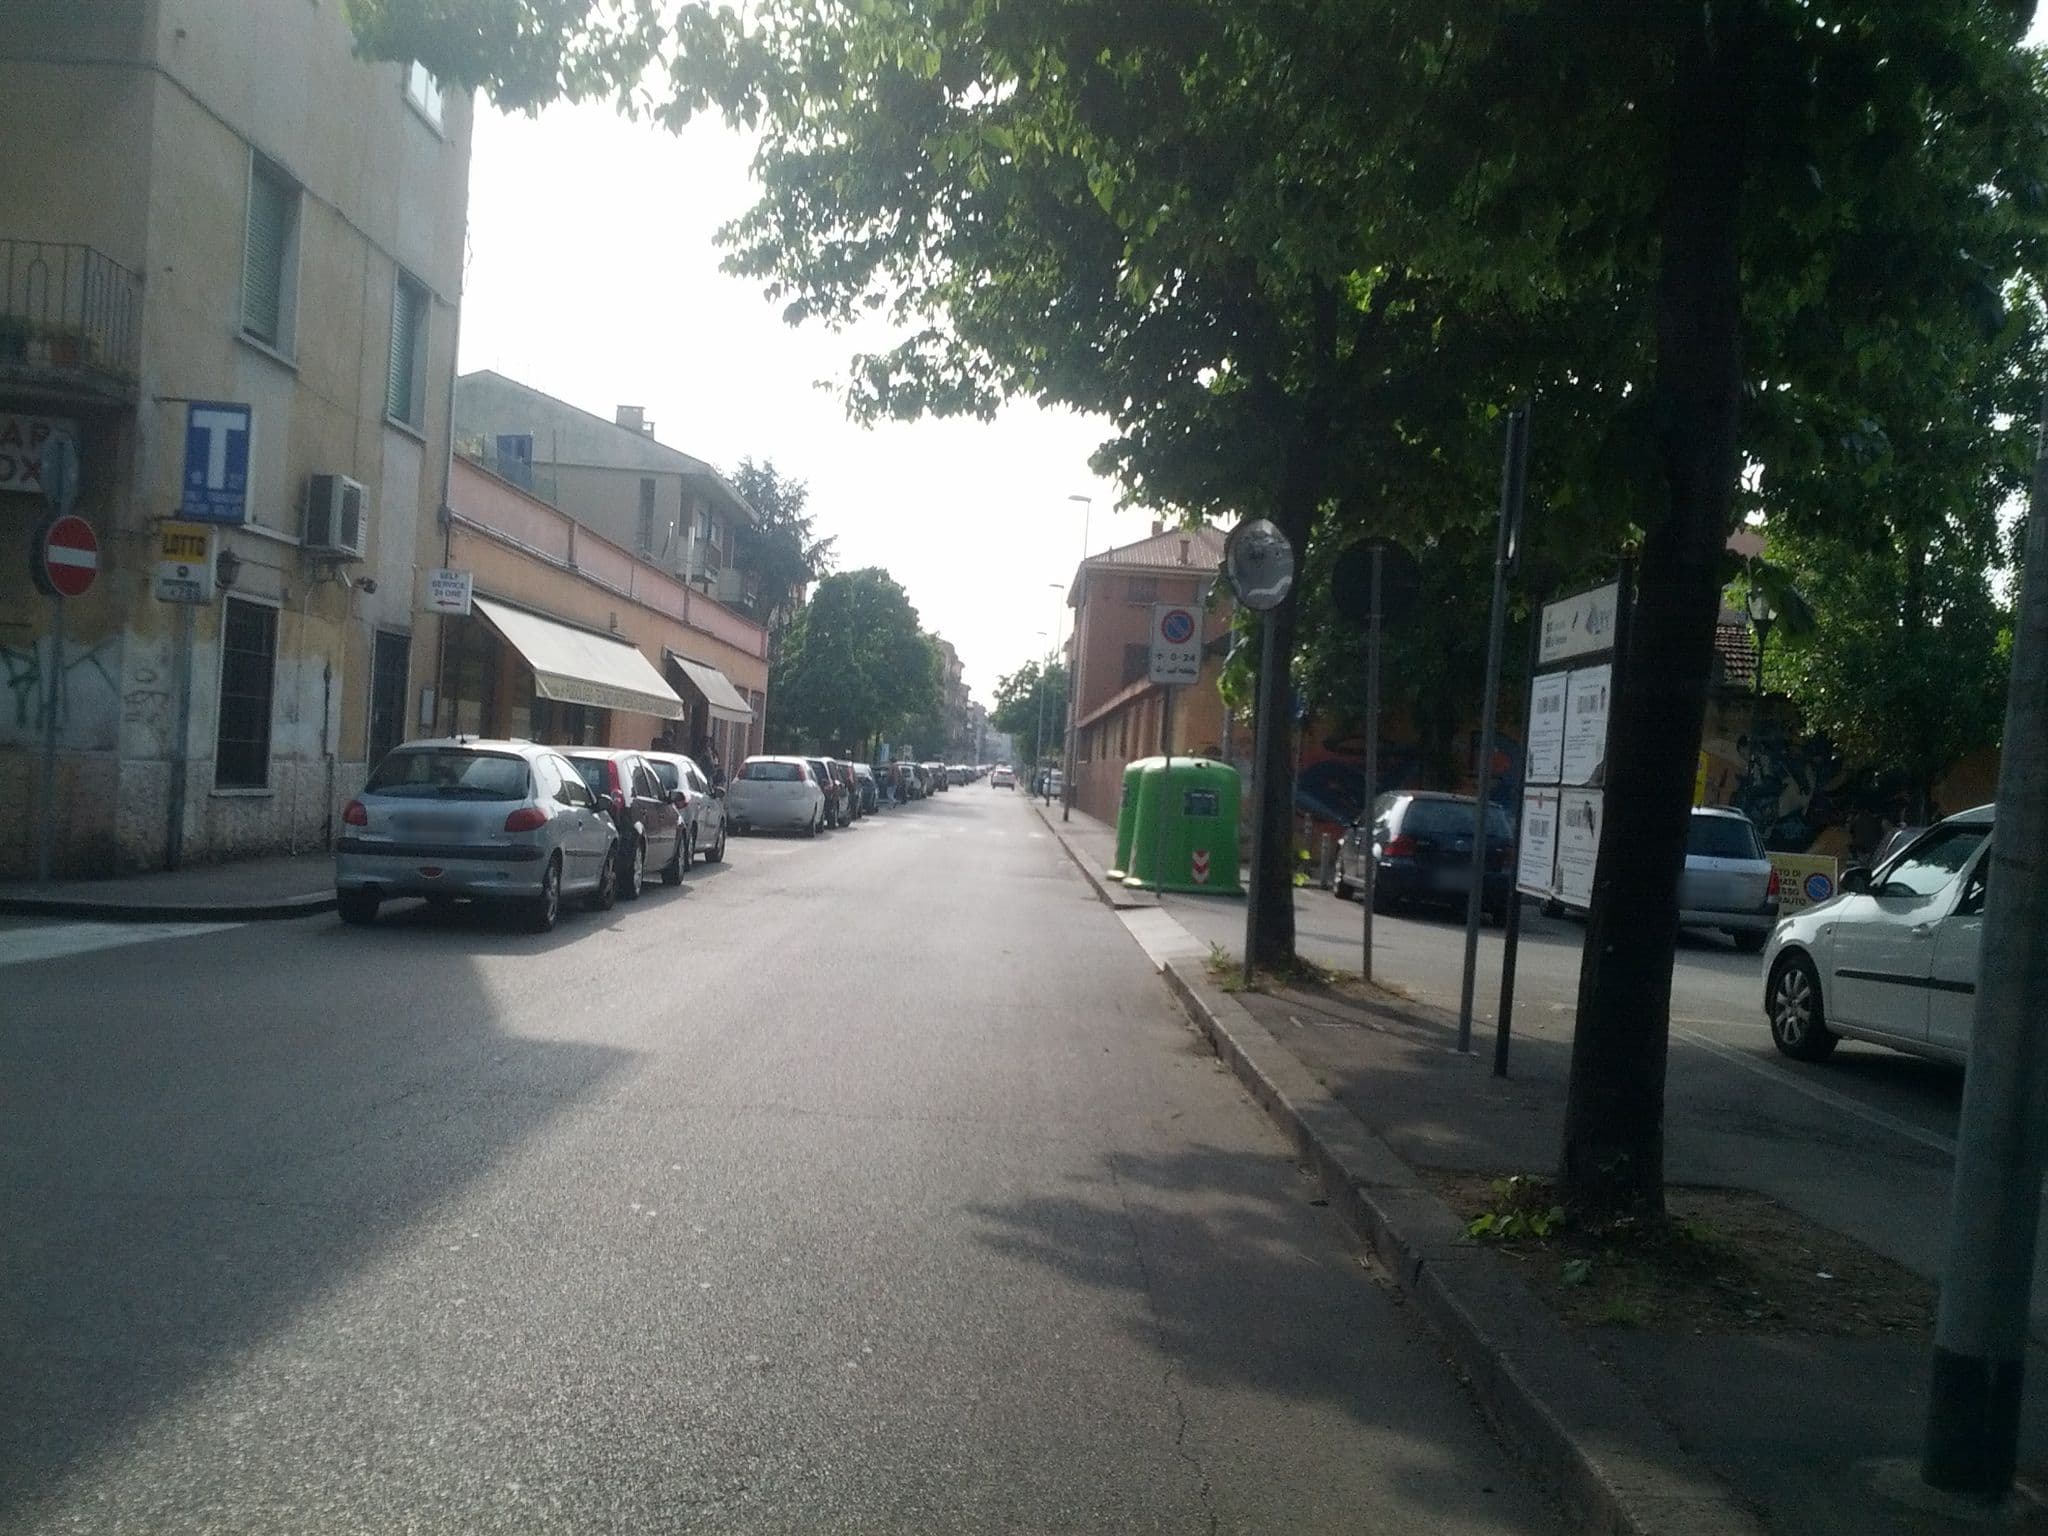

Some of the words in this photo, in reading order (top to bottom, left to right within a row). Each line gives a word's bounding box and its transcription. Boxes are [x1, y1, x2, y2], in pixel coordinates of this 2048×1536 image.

[191, 410, 247, 490] T
[431, 580, 465, 589] SERVICE
[444, 589, 462, 598] ORE
